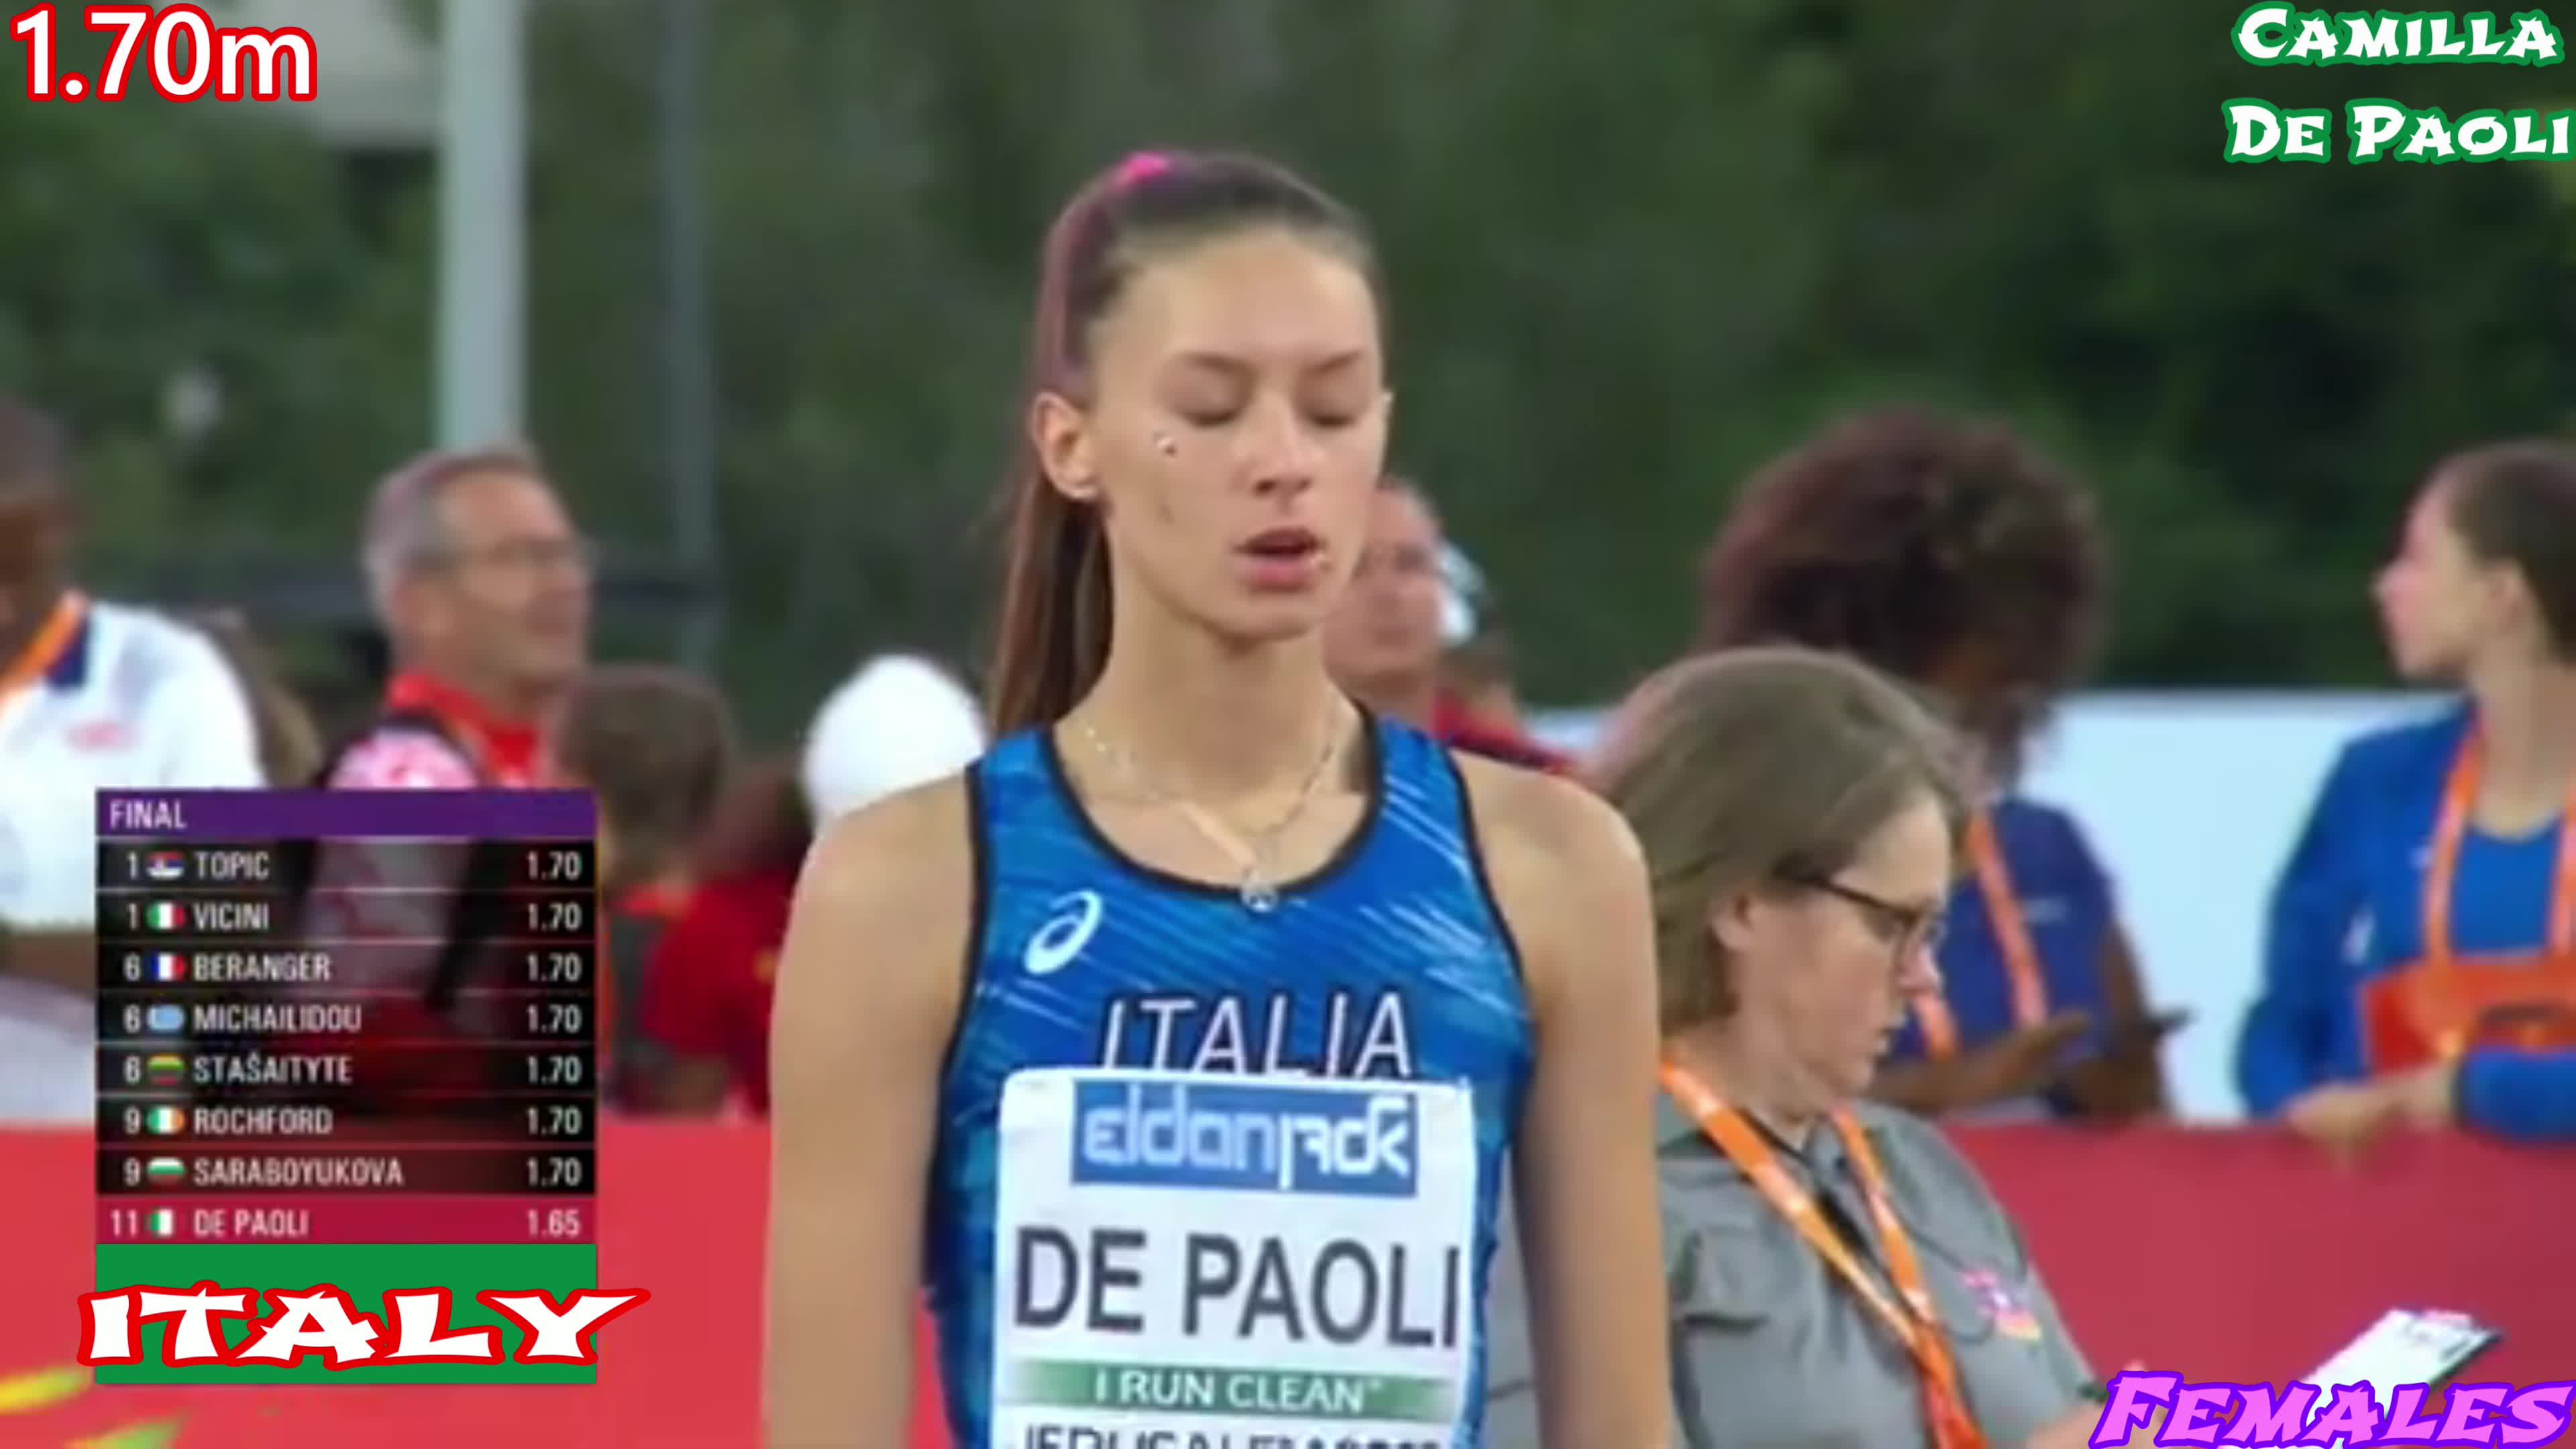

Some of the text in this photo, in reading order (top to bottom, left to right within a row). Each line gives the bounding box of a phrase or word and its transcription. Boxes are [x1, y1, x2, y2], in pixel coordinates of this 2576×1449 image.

[1104, 992, 1411, 1077] ITALIA
[1082, 1083, 1275, 1173] eldan
[1013, 1225, 1460, 1348] DE PAOLI
[1094, 1366, 1107, 1402] I
[1119, 1368, 1214, 1406] RUN
